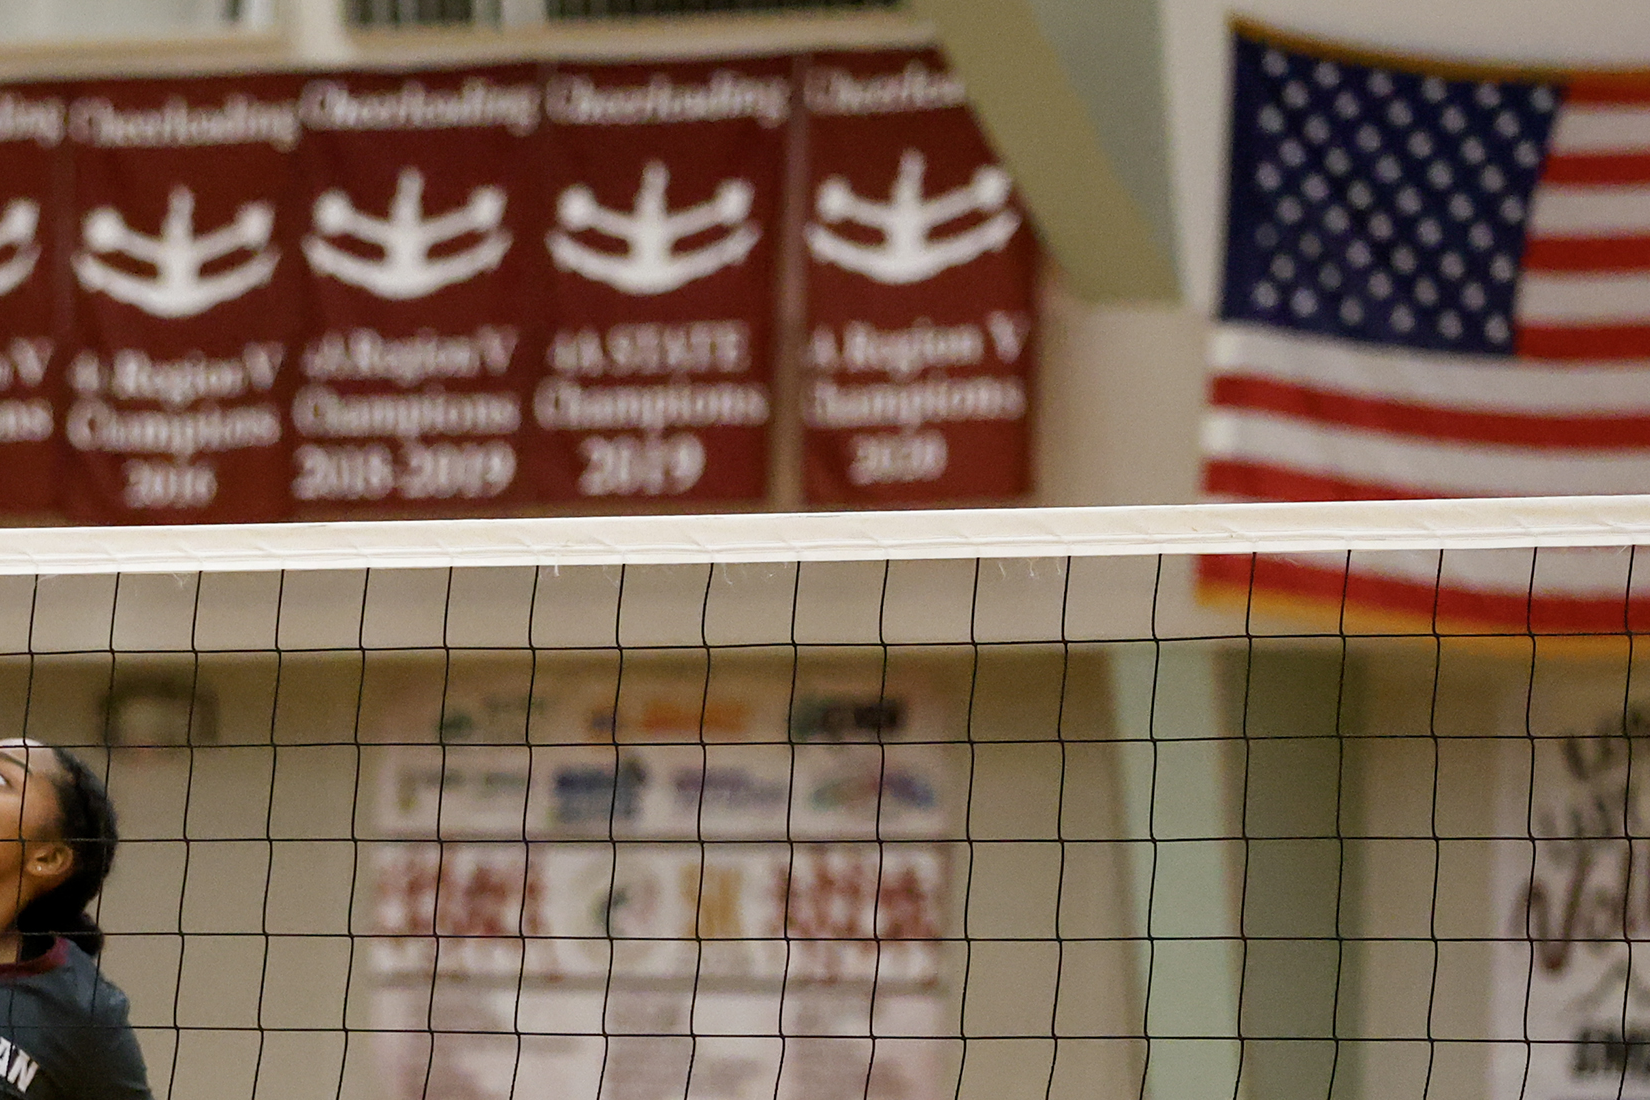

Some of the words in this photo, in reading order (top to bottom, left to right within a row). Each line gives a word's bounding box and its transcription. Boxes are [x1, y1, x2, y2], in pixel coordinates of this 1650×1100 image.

[68, 93, 298, 153] Cheerleading
[301, 77, 543, 136] Cheerleading
[549, 69, 790, 130] Cheerleading
[10, 336, 53, 387] V
[113, 348, 247, 408] Region
[244, 341, 286, 389] V
[348, 327, 482, 387] Region
[477, 324, 518, 376] V
[606, 319, 750, 376] STATE
[843, 319, 984, 383] Region
[986, 311, 1031, 364] V
[67, 397, 281, 455] Champions
[292, 382, 520, 437] Champions
[534, 375, 770, 430] Champions
[579, 434, 706, 496] 2019
